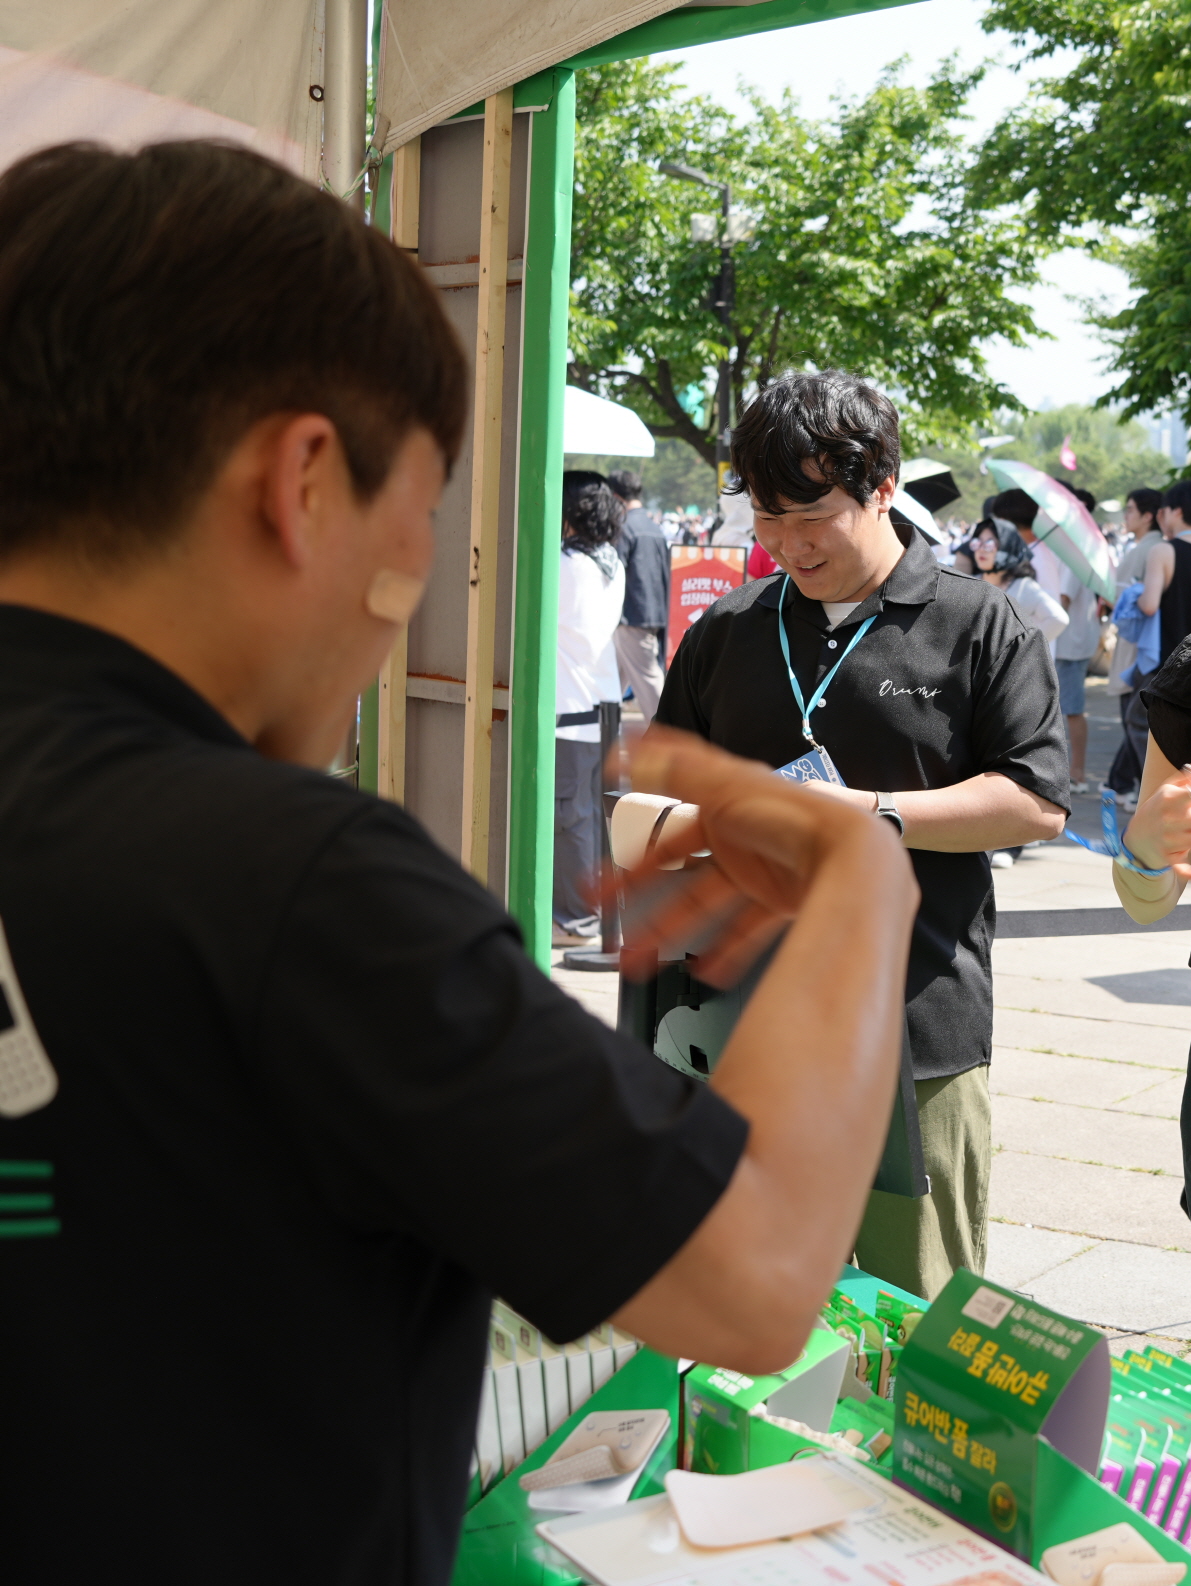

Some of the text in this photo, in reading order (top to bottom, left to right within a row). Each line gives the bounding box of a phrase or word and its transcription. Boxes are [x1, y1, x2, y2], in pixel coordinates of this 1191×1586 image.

[966, 1340, 1000, 1379] 폼
[986, 1354, 1050, 1404] 큐어반
[903, 1391, 951, 1445] 큐어반
[951, 1417, 969, 1460] 폼
